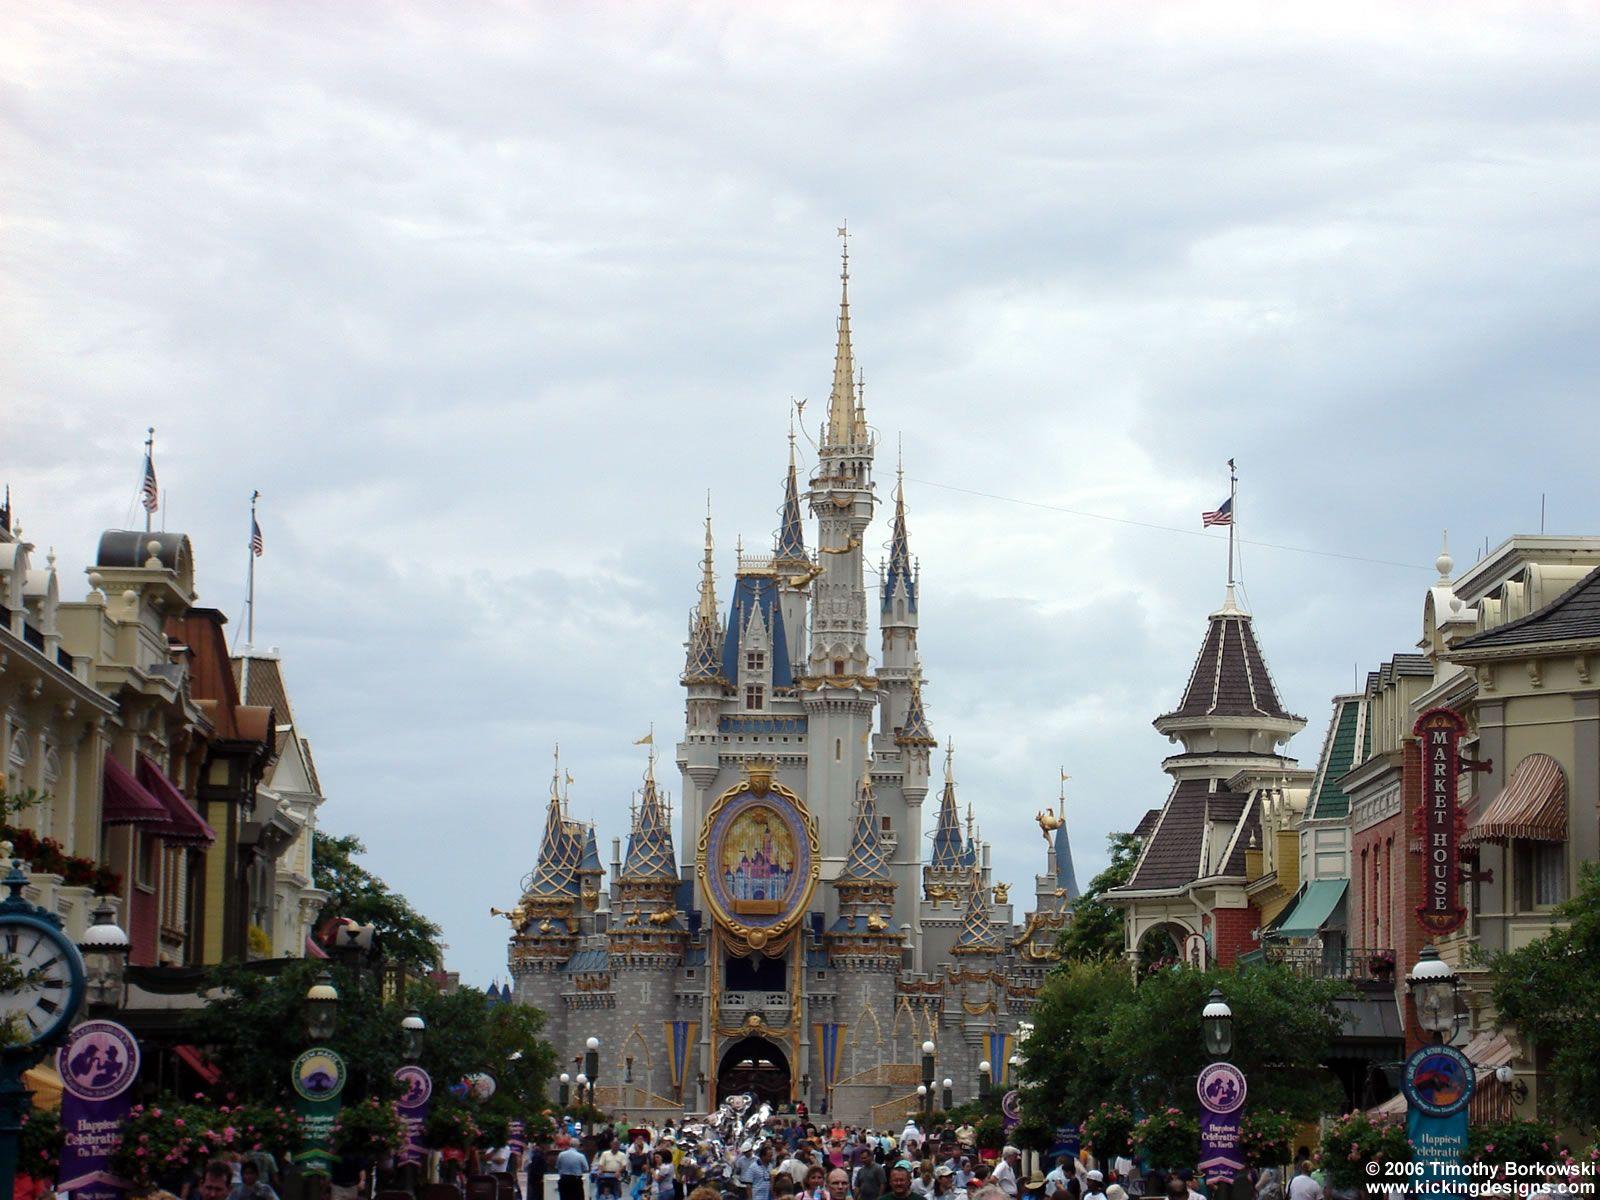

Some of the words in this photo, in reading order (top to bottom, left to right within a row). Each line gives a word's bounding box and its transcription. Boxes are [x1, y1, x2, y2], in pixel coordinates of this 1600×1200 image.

[1432, 731, 1448, 825] MARKET
[1432, 833, 1448, 910] HOUSE
[1209, 1123, 1236, 1133] Happiest
[1422, 1133, 1461, 1147] Happiest
